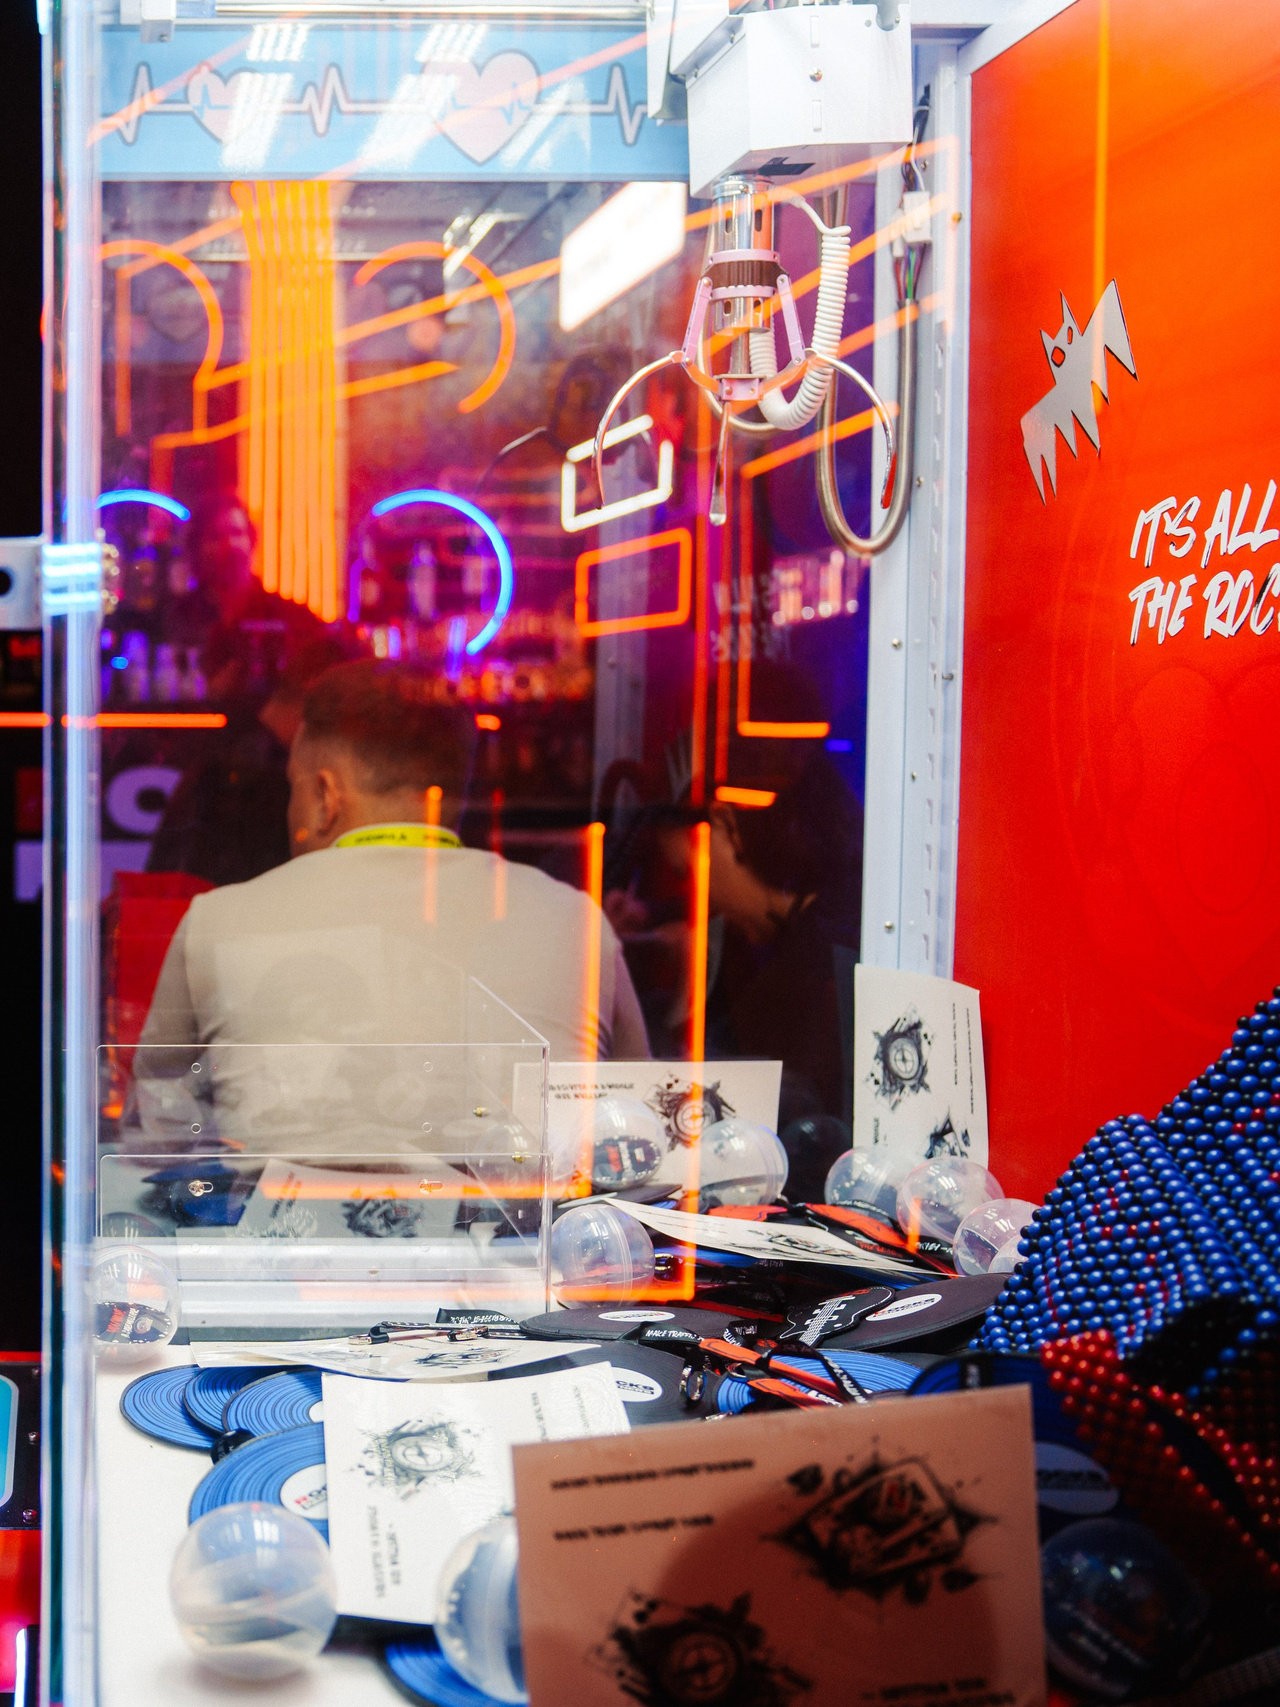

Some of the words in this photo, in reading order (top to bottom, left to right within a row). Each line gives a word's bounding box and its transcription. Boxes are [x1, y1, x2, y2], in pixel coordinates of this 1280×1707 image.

[1129, 495, 1201, 569] IT'S
[1128, 573, 1198, 648] THE
[1202, 562, 1280, 640] ROC
